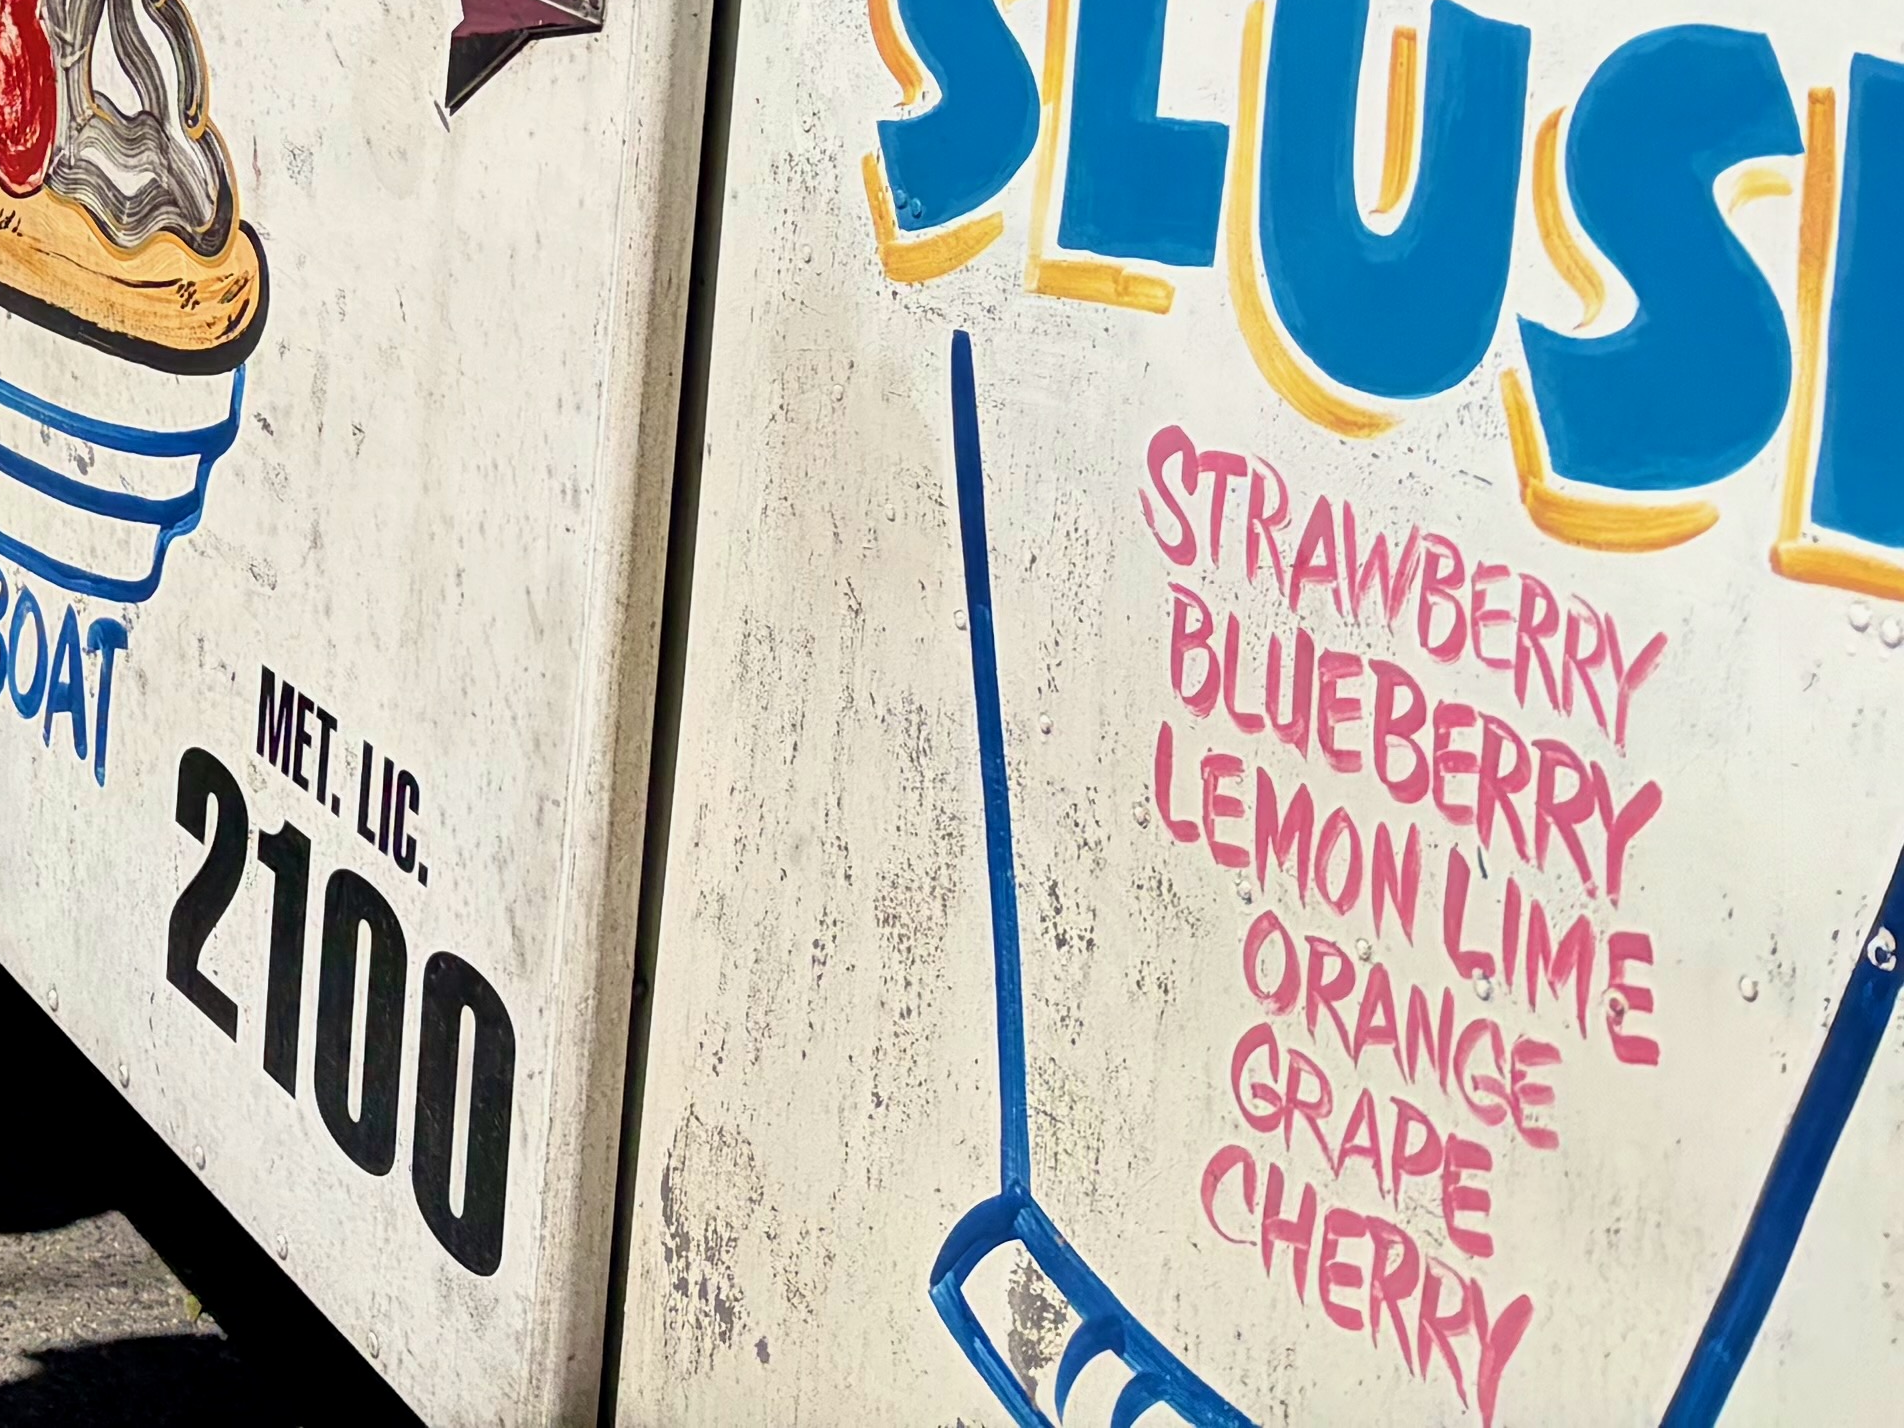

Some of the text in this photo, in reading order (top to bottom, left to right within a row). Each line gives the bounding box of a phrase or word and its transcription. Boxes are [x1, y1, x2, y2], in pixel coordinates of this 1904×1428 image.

[1139, 425, 1669, 751] STRAWBERRY
[258, 664, 430, 886] MET. LIC.
[1166, 581, 1663, 900] BLUEBERRY
[164, 744, 516, 1277] 2100
[1152, 719, 1660, 1066] LEMON LIME
[1242, 910, 1561, 1150] ORANGE
[1200, 1144, 1532, 1406] CHERRY
[1231, 1022, 1493, 1258] GRAPE
